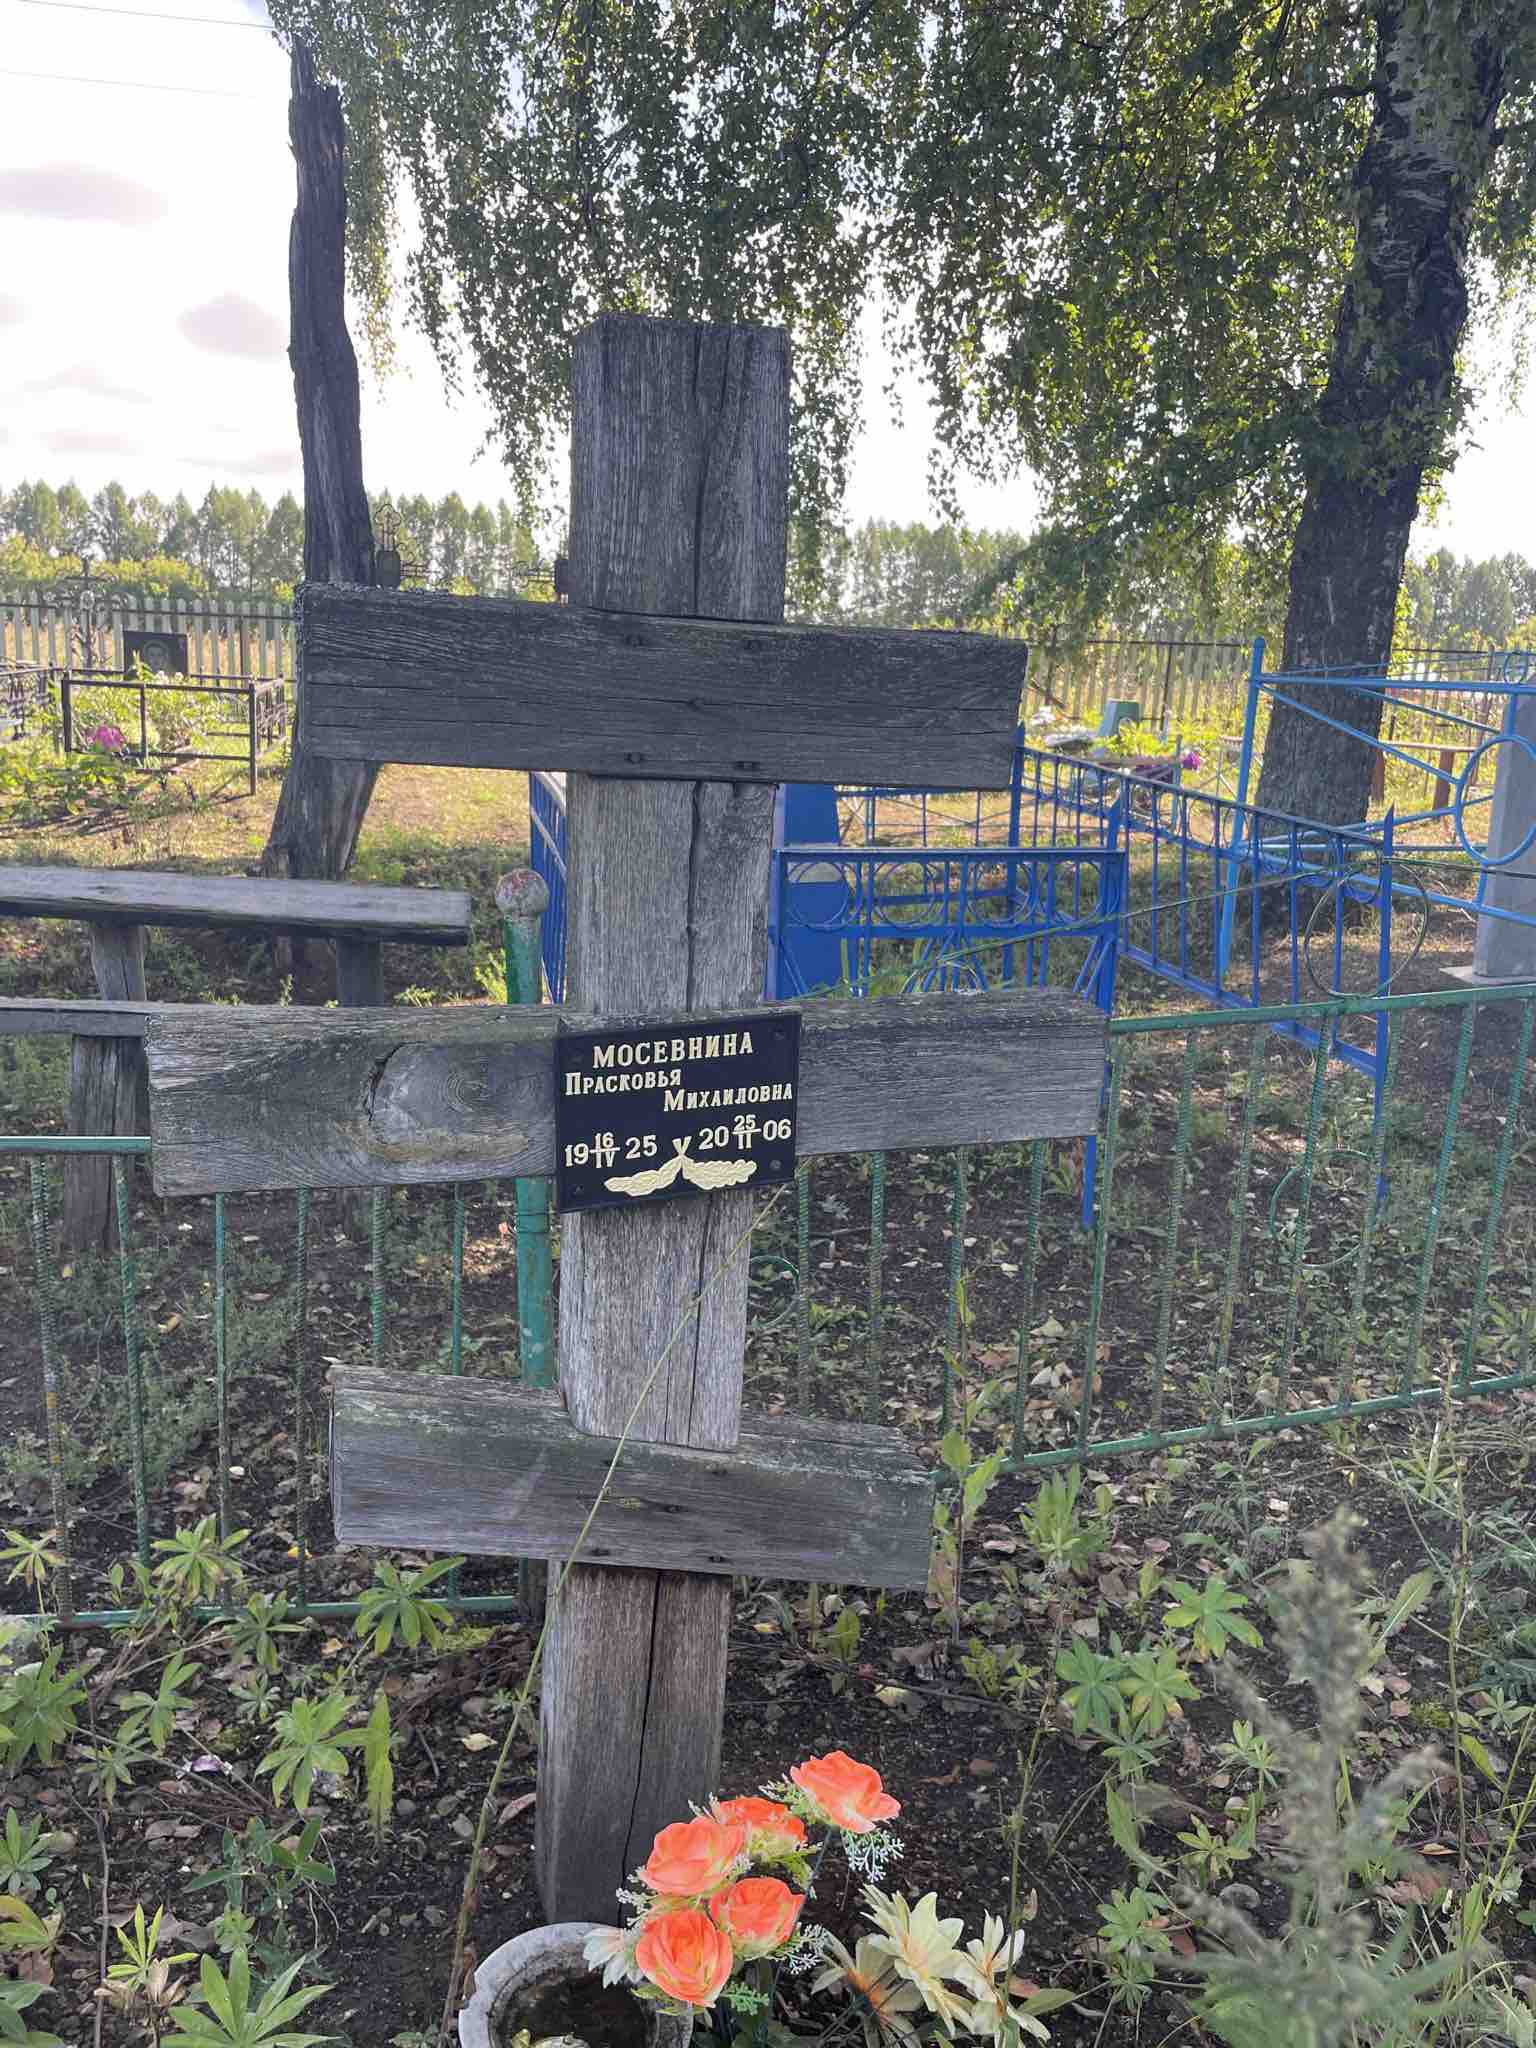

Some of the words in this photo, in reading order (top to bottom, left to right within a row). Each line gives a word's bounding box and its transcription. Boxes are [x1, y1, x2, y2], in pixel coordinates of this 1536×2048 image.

[592, 1031, 753, 1069] МОСЕВНИНА
[564, 1142, 590, 1167] 19
[594, 1132, 615, 1149] 16
[625, 1134, 658, 1160] 25
[698, 1126, 730, 1151] 20
[733, 1114, 757, 1132] 25
[762, 1118, 792, 1141] 06
